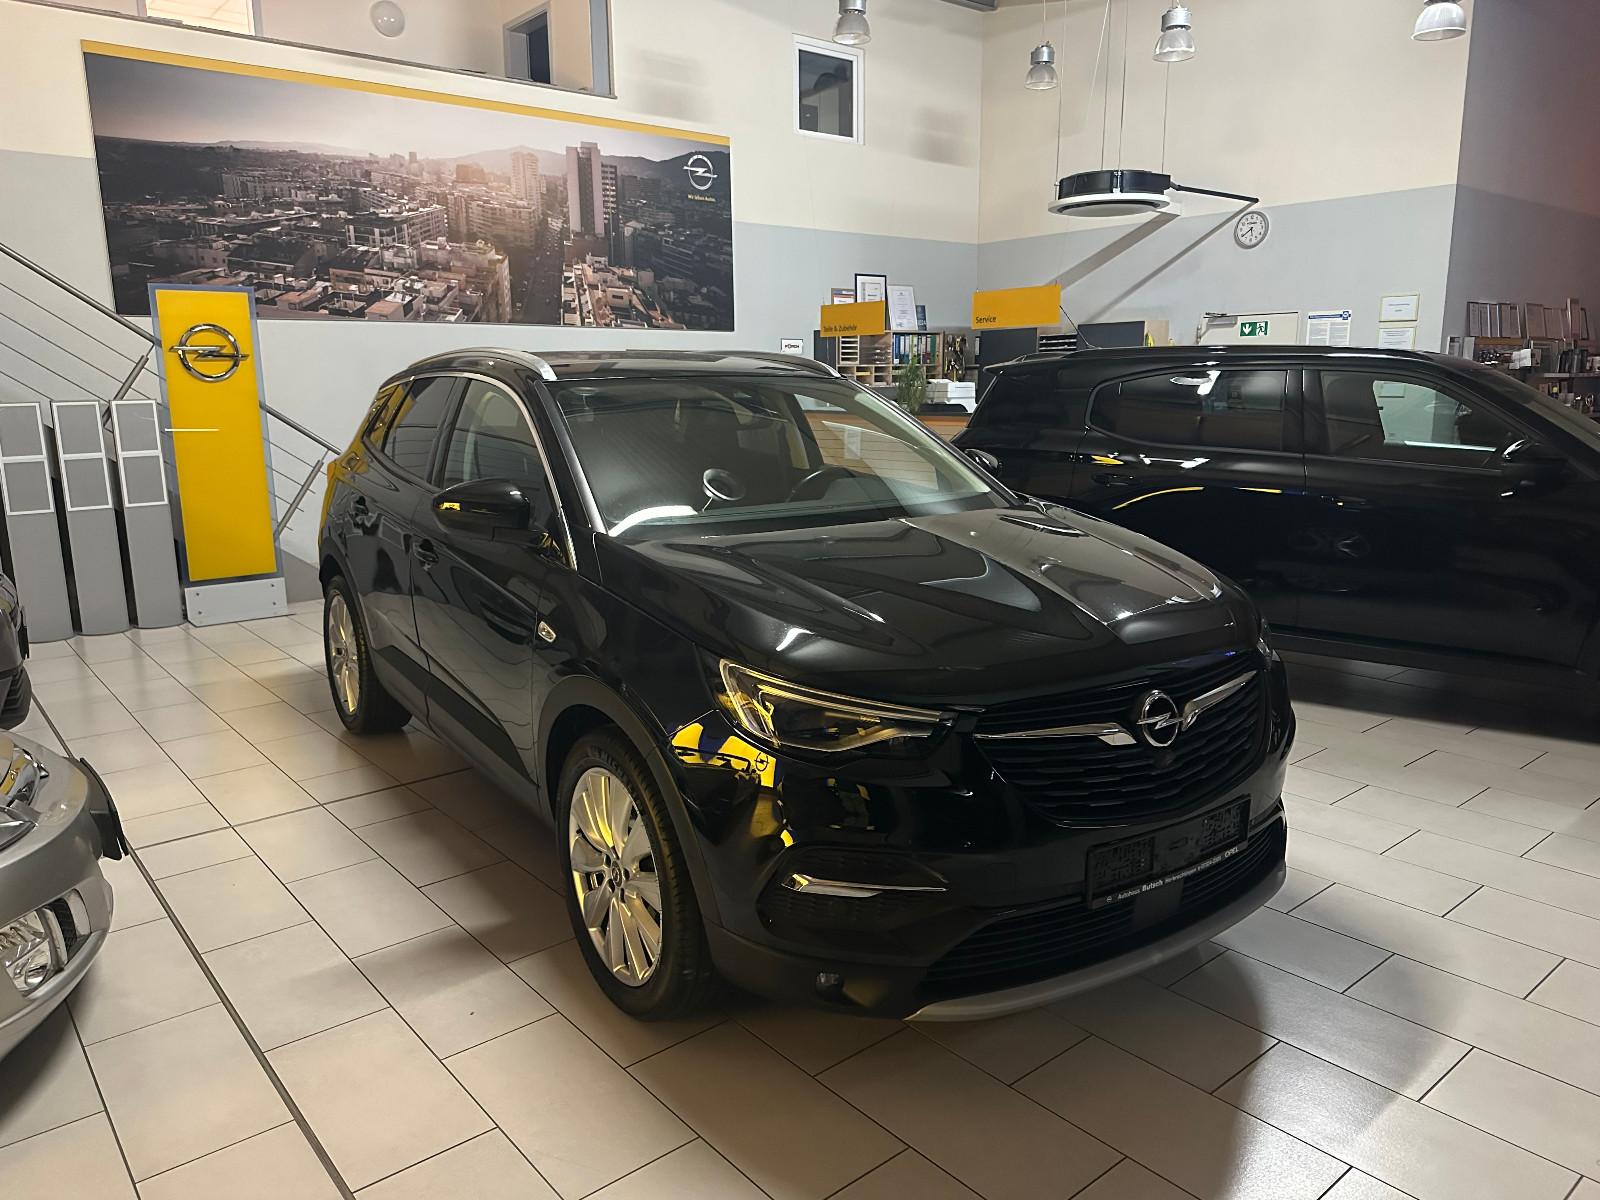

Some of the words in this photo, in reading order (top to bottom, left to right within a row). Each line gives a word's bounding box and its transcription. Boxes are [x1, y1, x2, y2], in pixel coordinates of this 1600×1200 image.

[975, 316, 997, 324] Service
[1117, 889, 1141, 900] Autohaus
[1142, 879, 1164, 892] Butsch
[1224, 846, 1239, 858] OPEL
